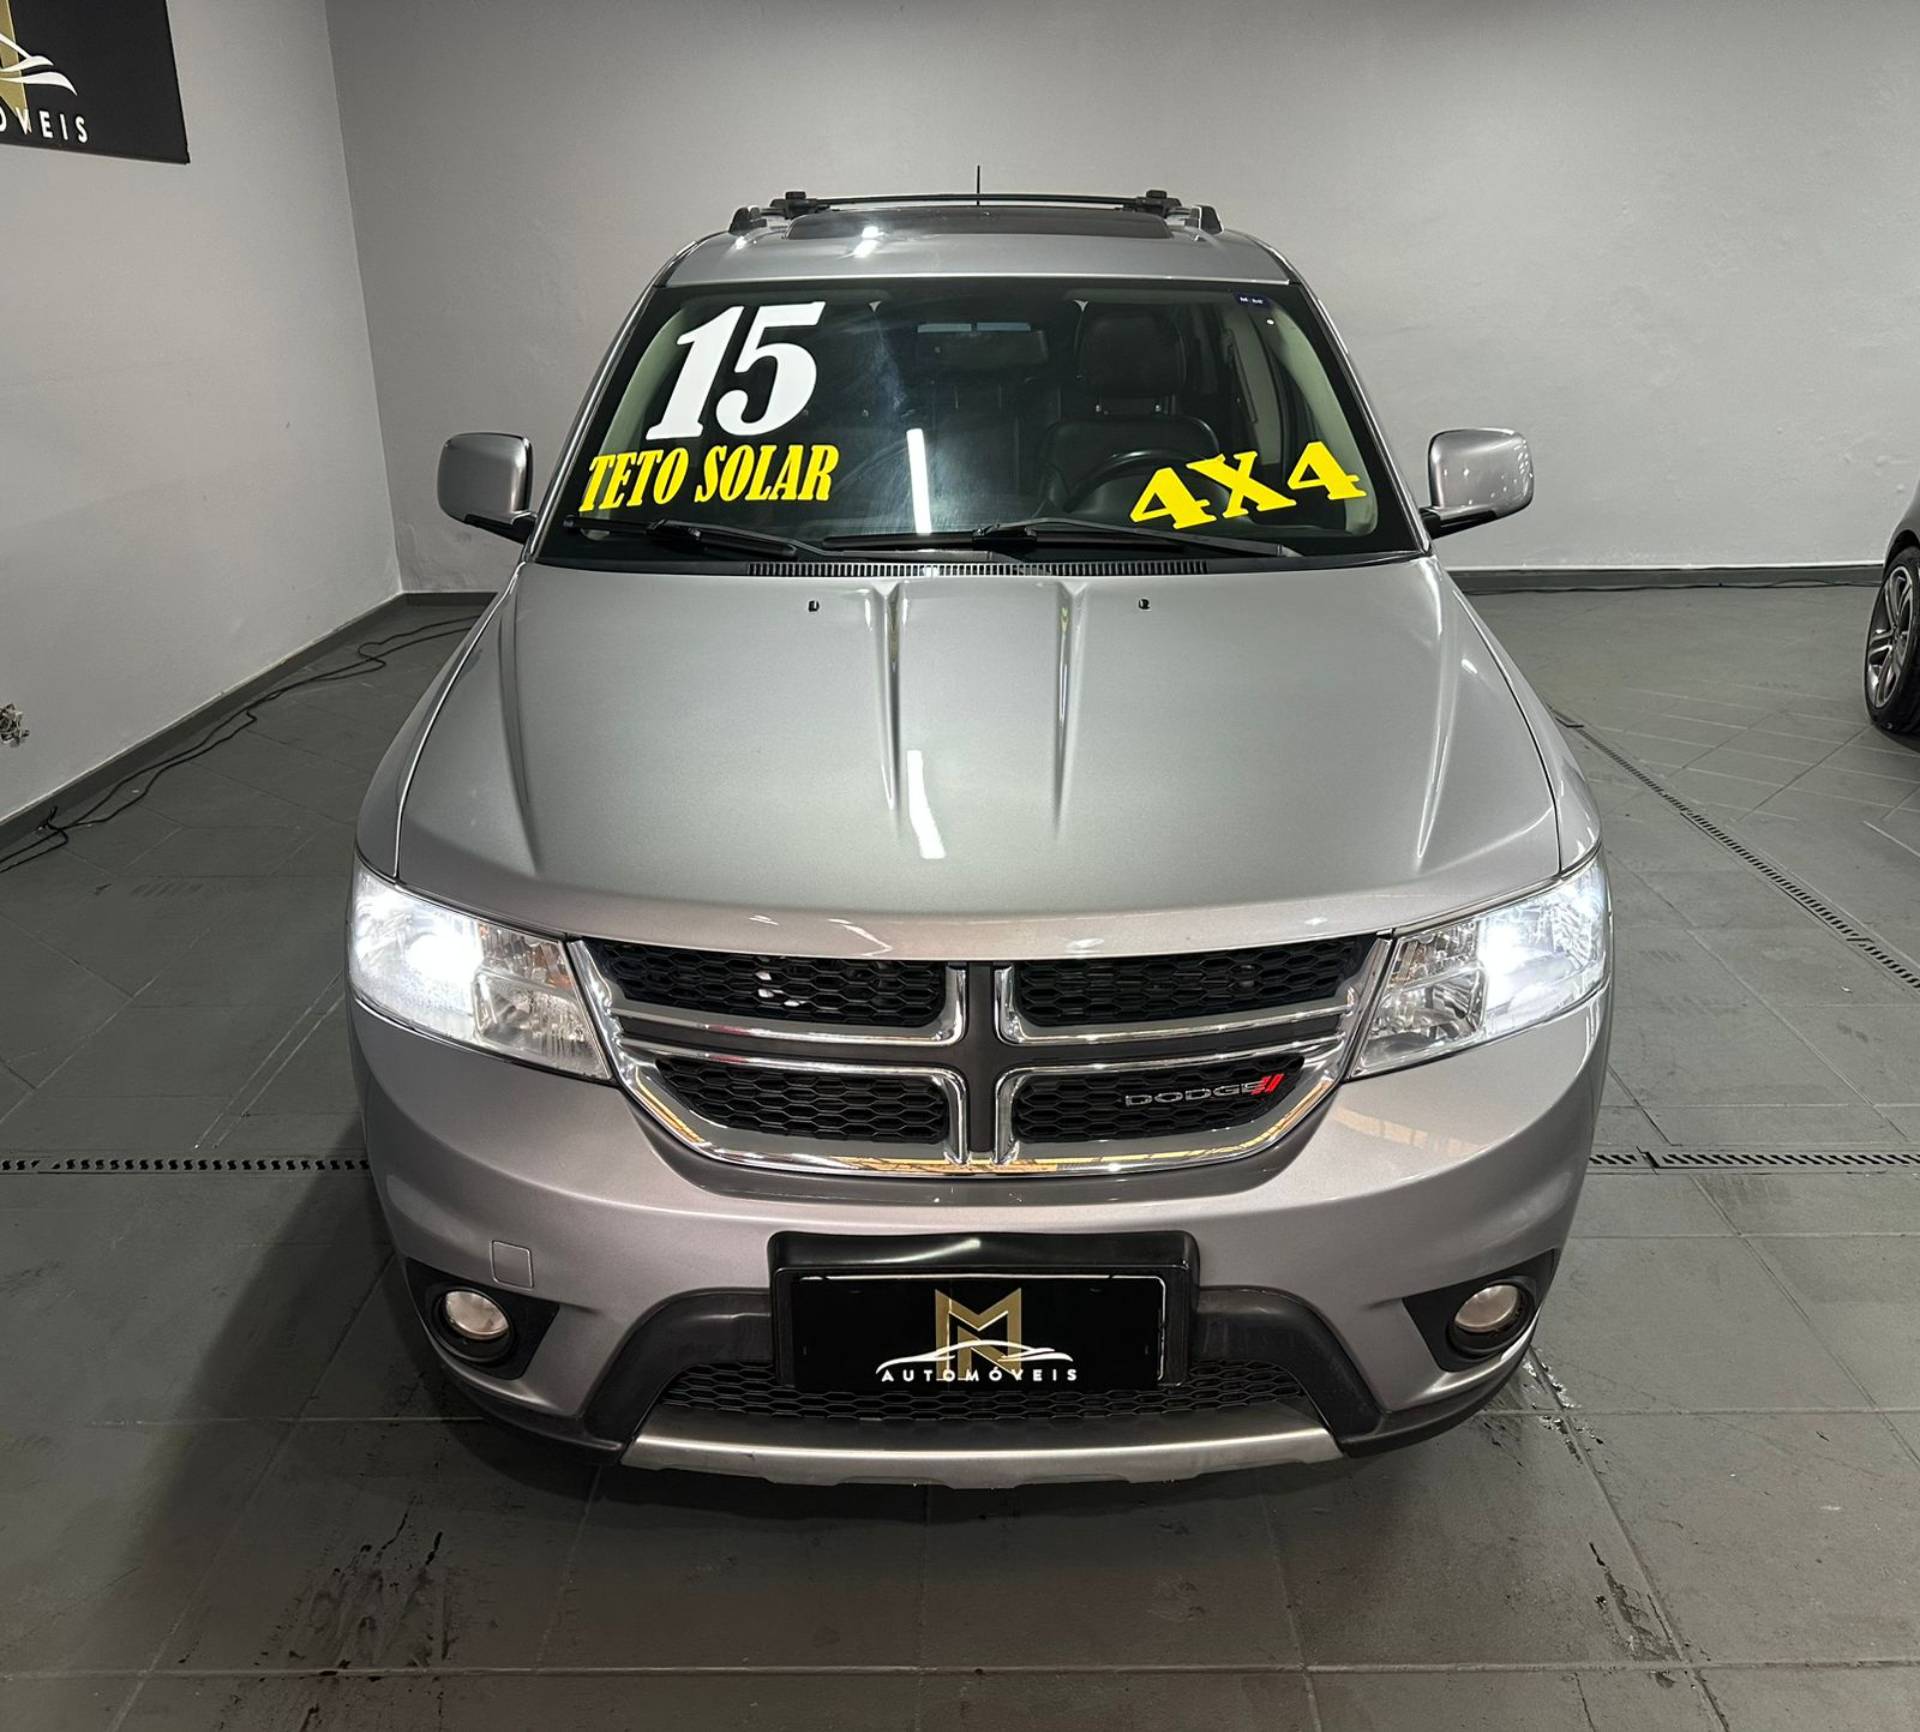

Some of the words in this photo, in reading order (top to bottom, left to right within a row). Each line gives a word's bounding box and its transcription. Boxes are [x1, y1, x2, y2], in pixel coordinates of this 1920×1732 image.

[645, 301, 826, 440] 15
[578, 447, 689, 512] TETO
[694, 445, 839, 502] SOLAR
[1130, 441, 1367, 529] 4X4
[1125, 1080, 1267, 1106] DODGE
[881, 1367, 1077, 1382] AUTOMÓVEIS
